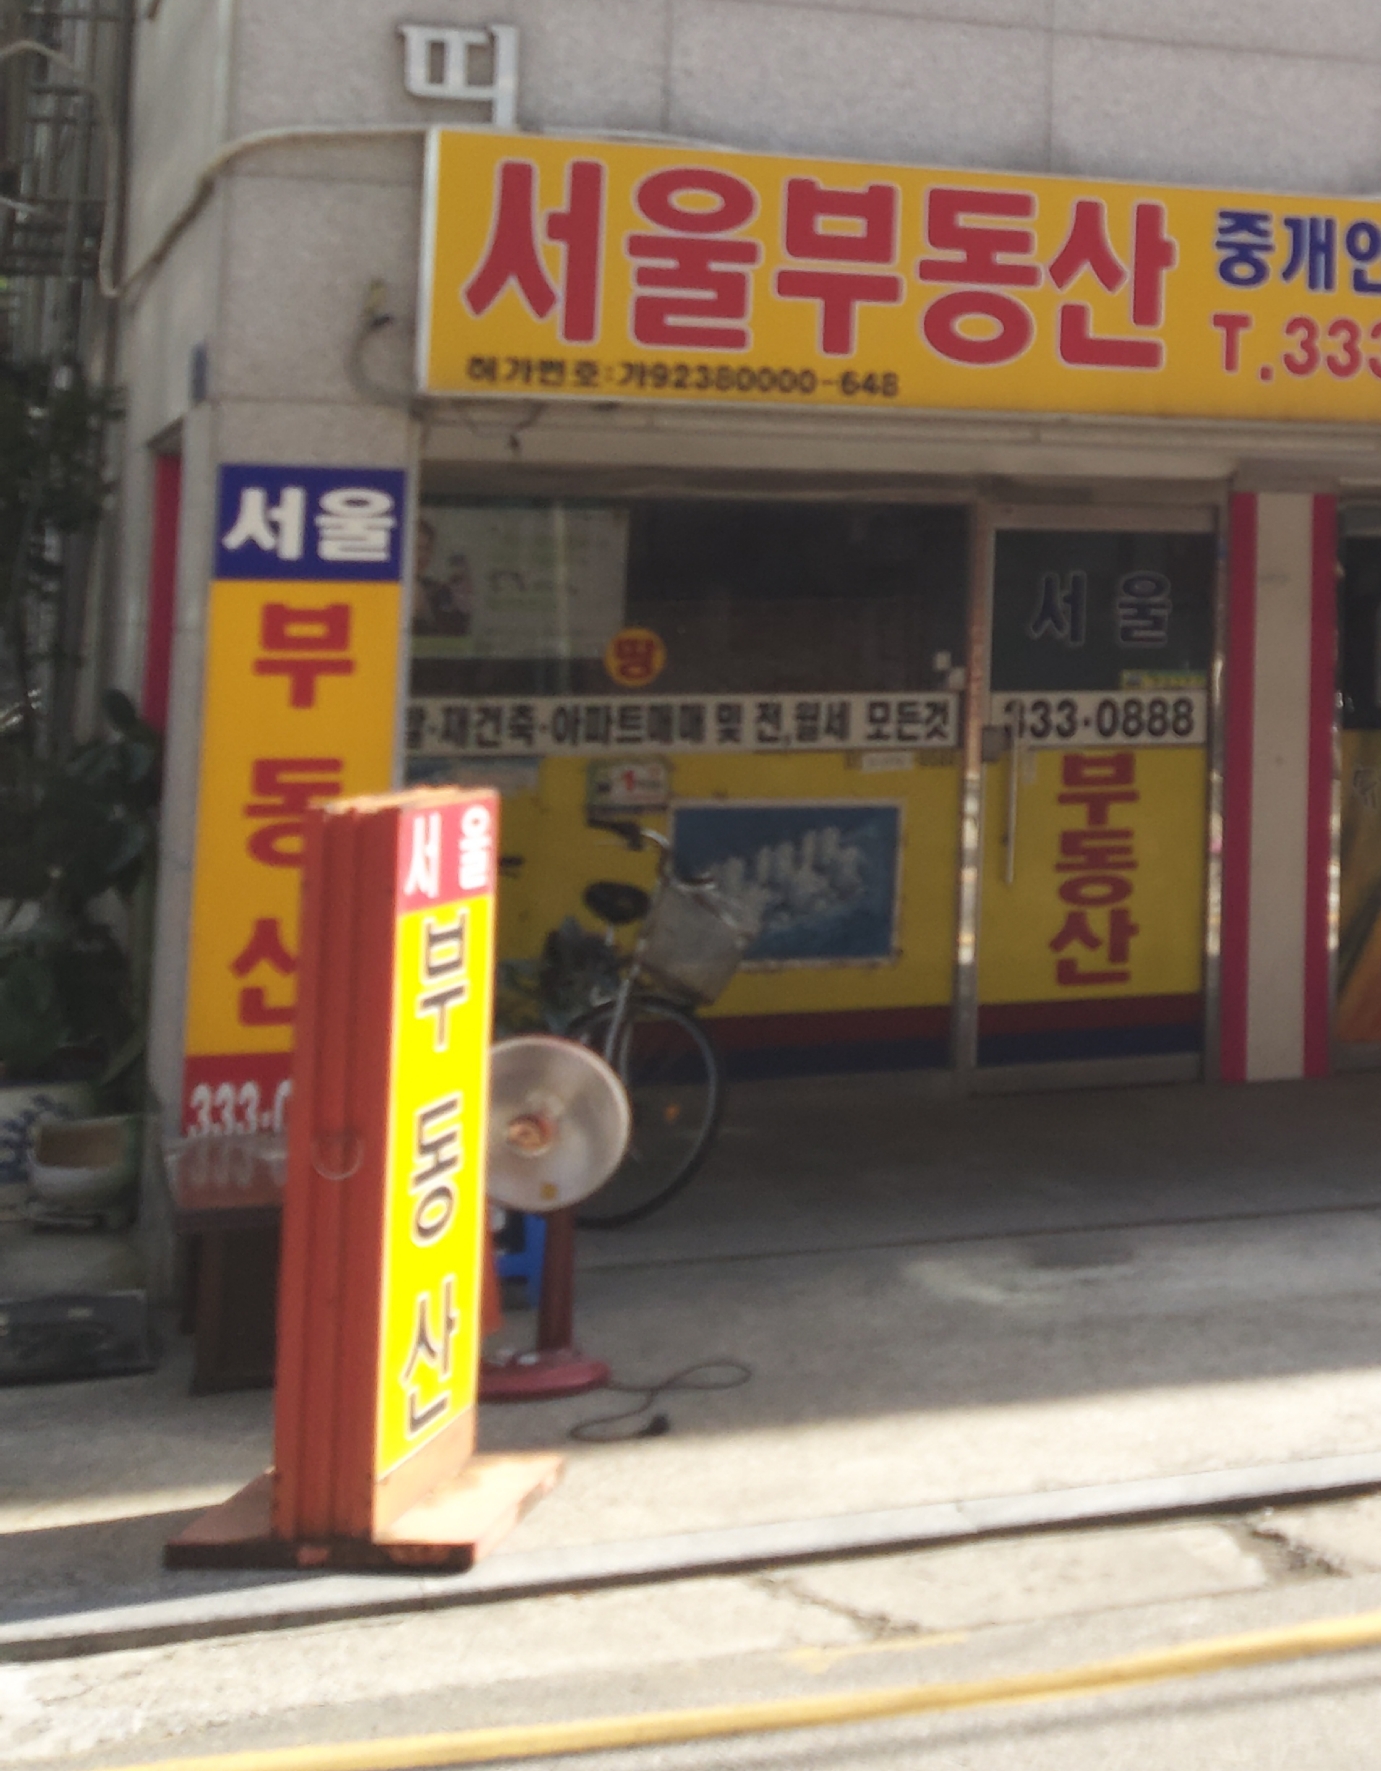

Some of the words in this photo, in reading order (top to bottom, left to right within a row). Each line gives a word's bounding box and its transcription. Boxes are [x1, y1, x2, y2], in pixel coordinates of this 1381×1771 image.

[461, 159, 1178, 369] 서울부동산
[222, 486, 395, 562] 서울
[1030, 570, 1172, 647] 서울
[866, 700, 950, 741] 모든것
[404, 805, 492, 899] 서울
[1049, 753, 1140, 987] 부동산
[402, 910, 470, 1435] 부동산
